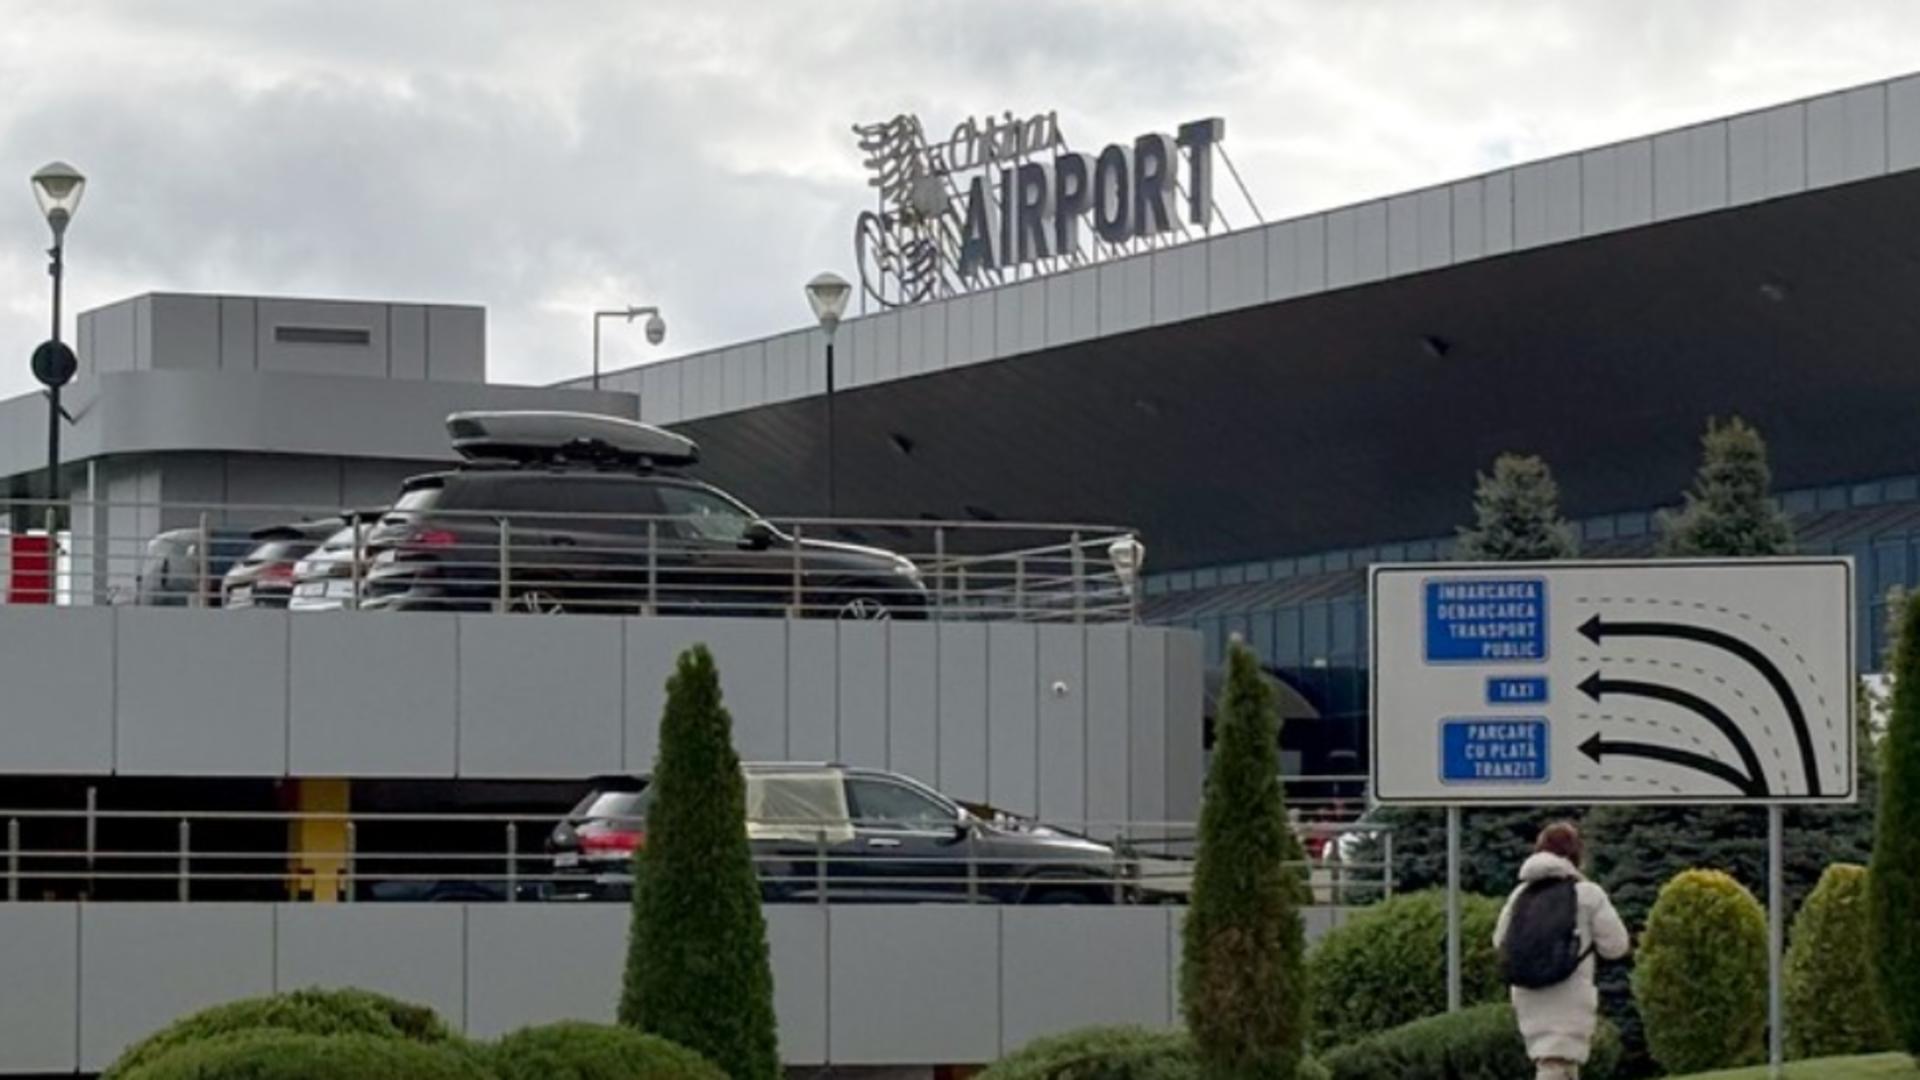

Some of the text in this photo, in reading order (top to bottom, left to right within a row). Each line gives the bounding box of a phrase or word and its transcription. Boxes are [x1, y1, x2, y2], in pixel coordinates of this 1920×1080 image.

[958, 117, 1225, 277] AIRPORT
[1437, 603, 1536, 620] DEBARCAREA
[1449, 622, 1536, 639] TRANSPORT
[1482, 642, 1536, 657] PUBLIC
[1501, 683, 1535, 697] TAXI
[1468, 725, 1536, 740] PARCARE
[1464, 743, 1486, 759] CU
[1475, 761, 1536, 777] TRANZIT
